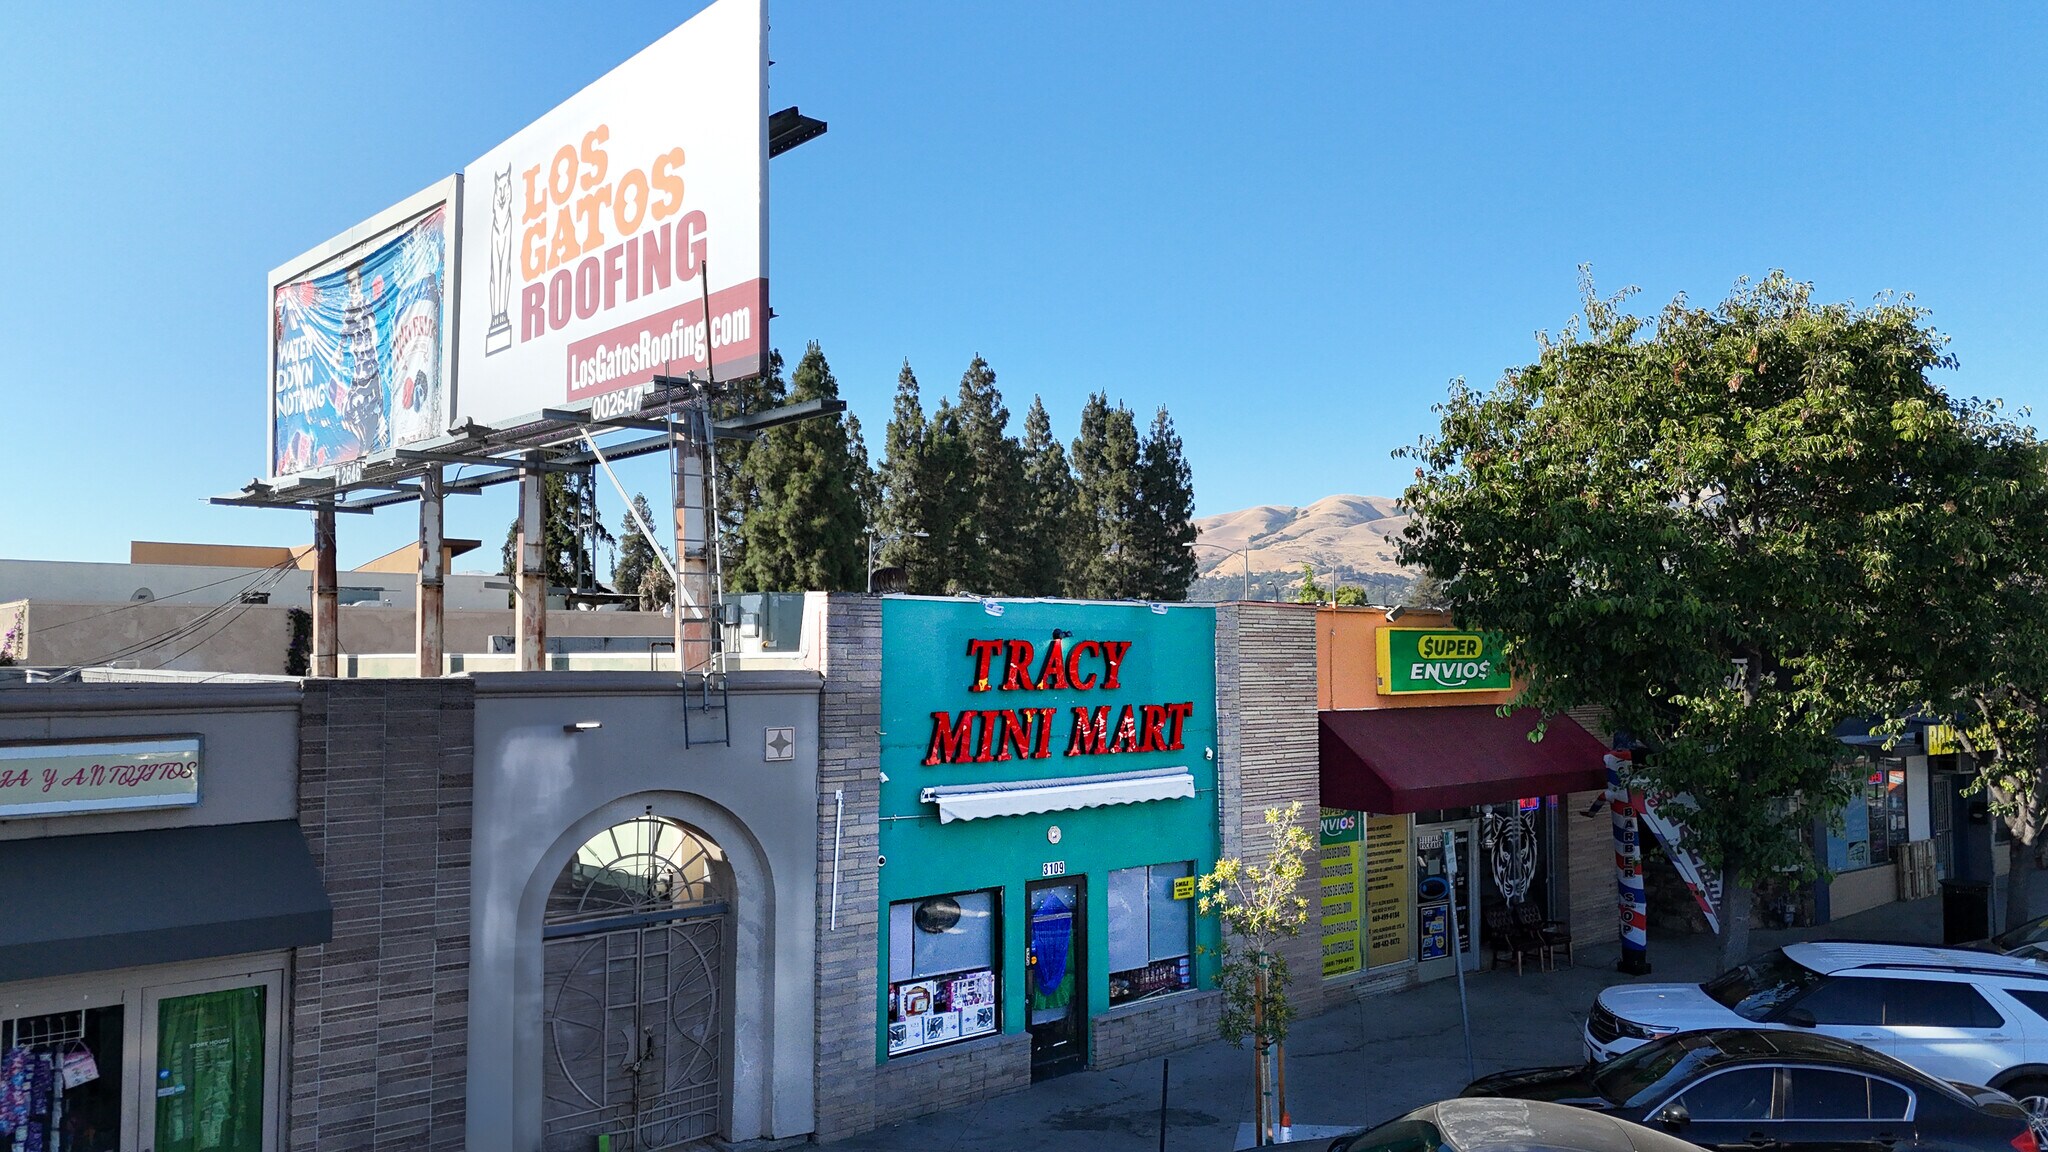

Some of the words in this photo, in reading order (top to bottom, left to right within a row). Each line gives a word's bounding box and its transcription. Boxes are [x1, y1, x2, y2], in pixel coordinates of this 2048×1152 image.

[522, 124, 609, 225] LOS
[520, 147, 686, 282] GATOS
[521, 210, 707, 343] ROOFING
[278, 337, 314, 364] WATER
[571, 306, 751, 392] LosGatosRoofingcom
[276, 359, 314, 393] DOWN
[276, 384, 326, 418] NOTHING
[592, 386, 643, 420] 002647
[967, 638, 1132, 692] TRACY
[921, 707, 1057, 766] MINI
[1064, 702, 1193, 757] MART
[42, 768, 58, 793] Y
[62, 761, 198, 787] ANTOJITOS
[1623, 807, 1635, 878] BARBER
[1043, 862, 1064, 875] 3109
[1622, 893, 1636, 936] SOP
